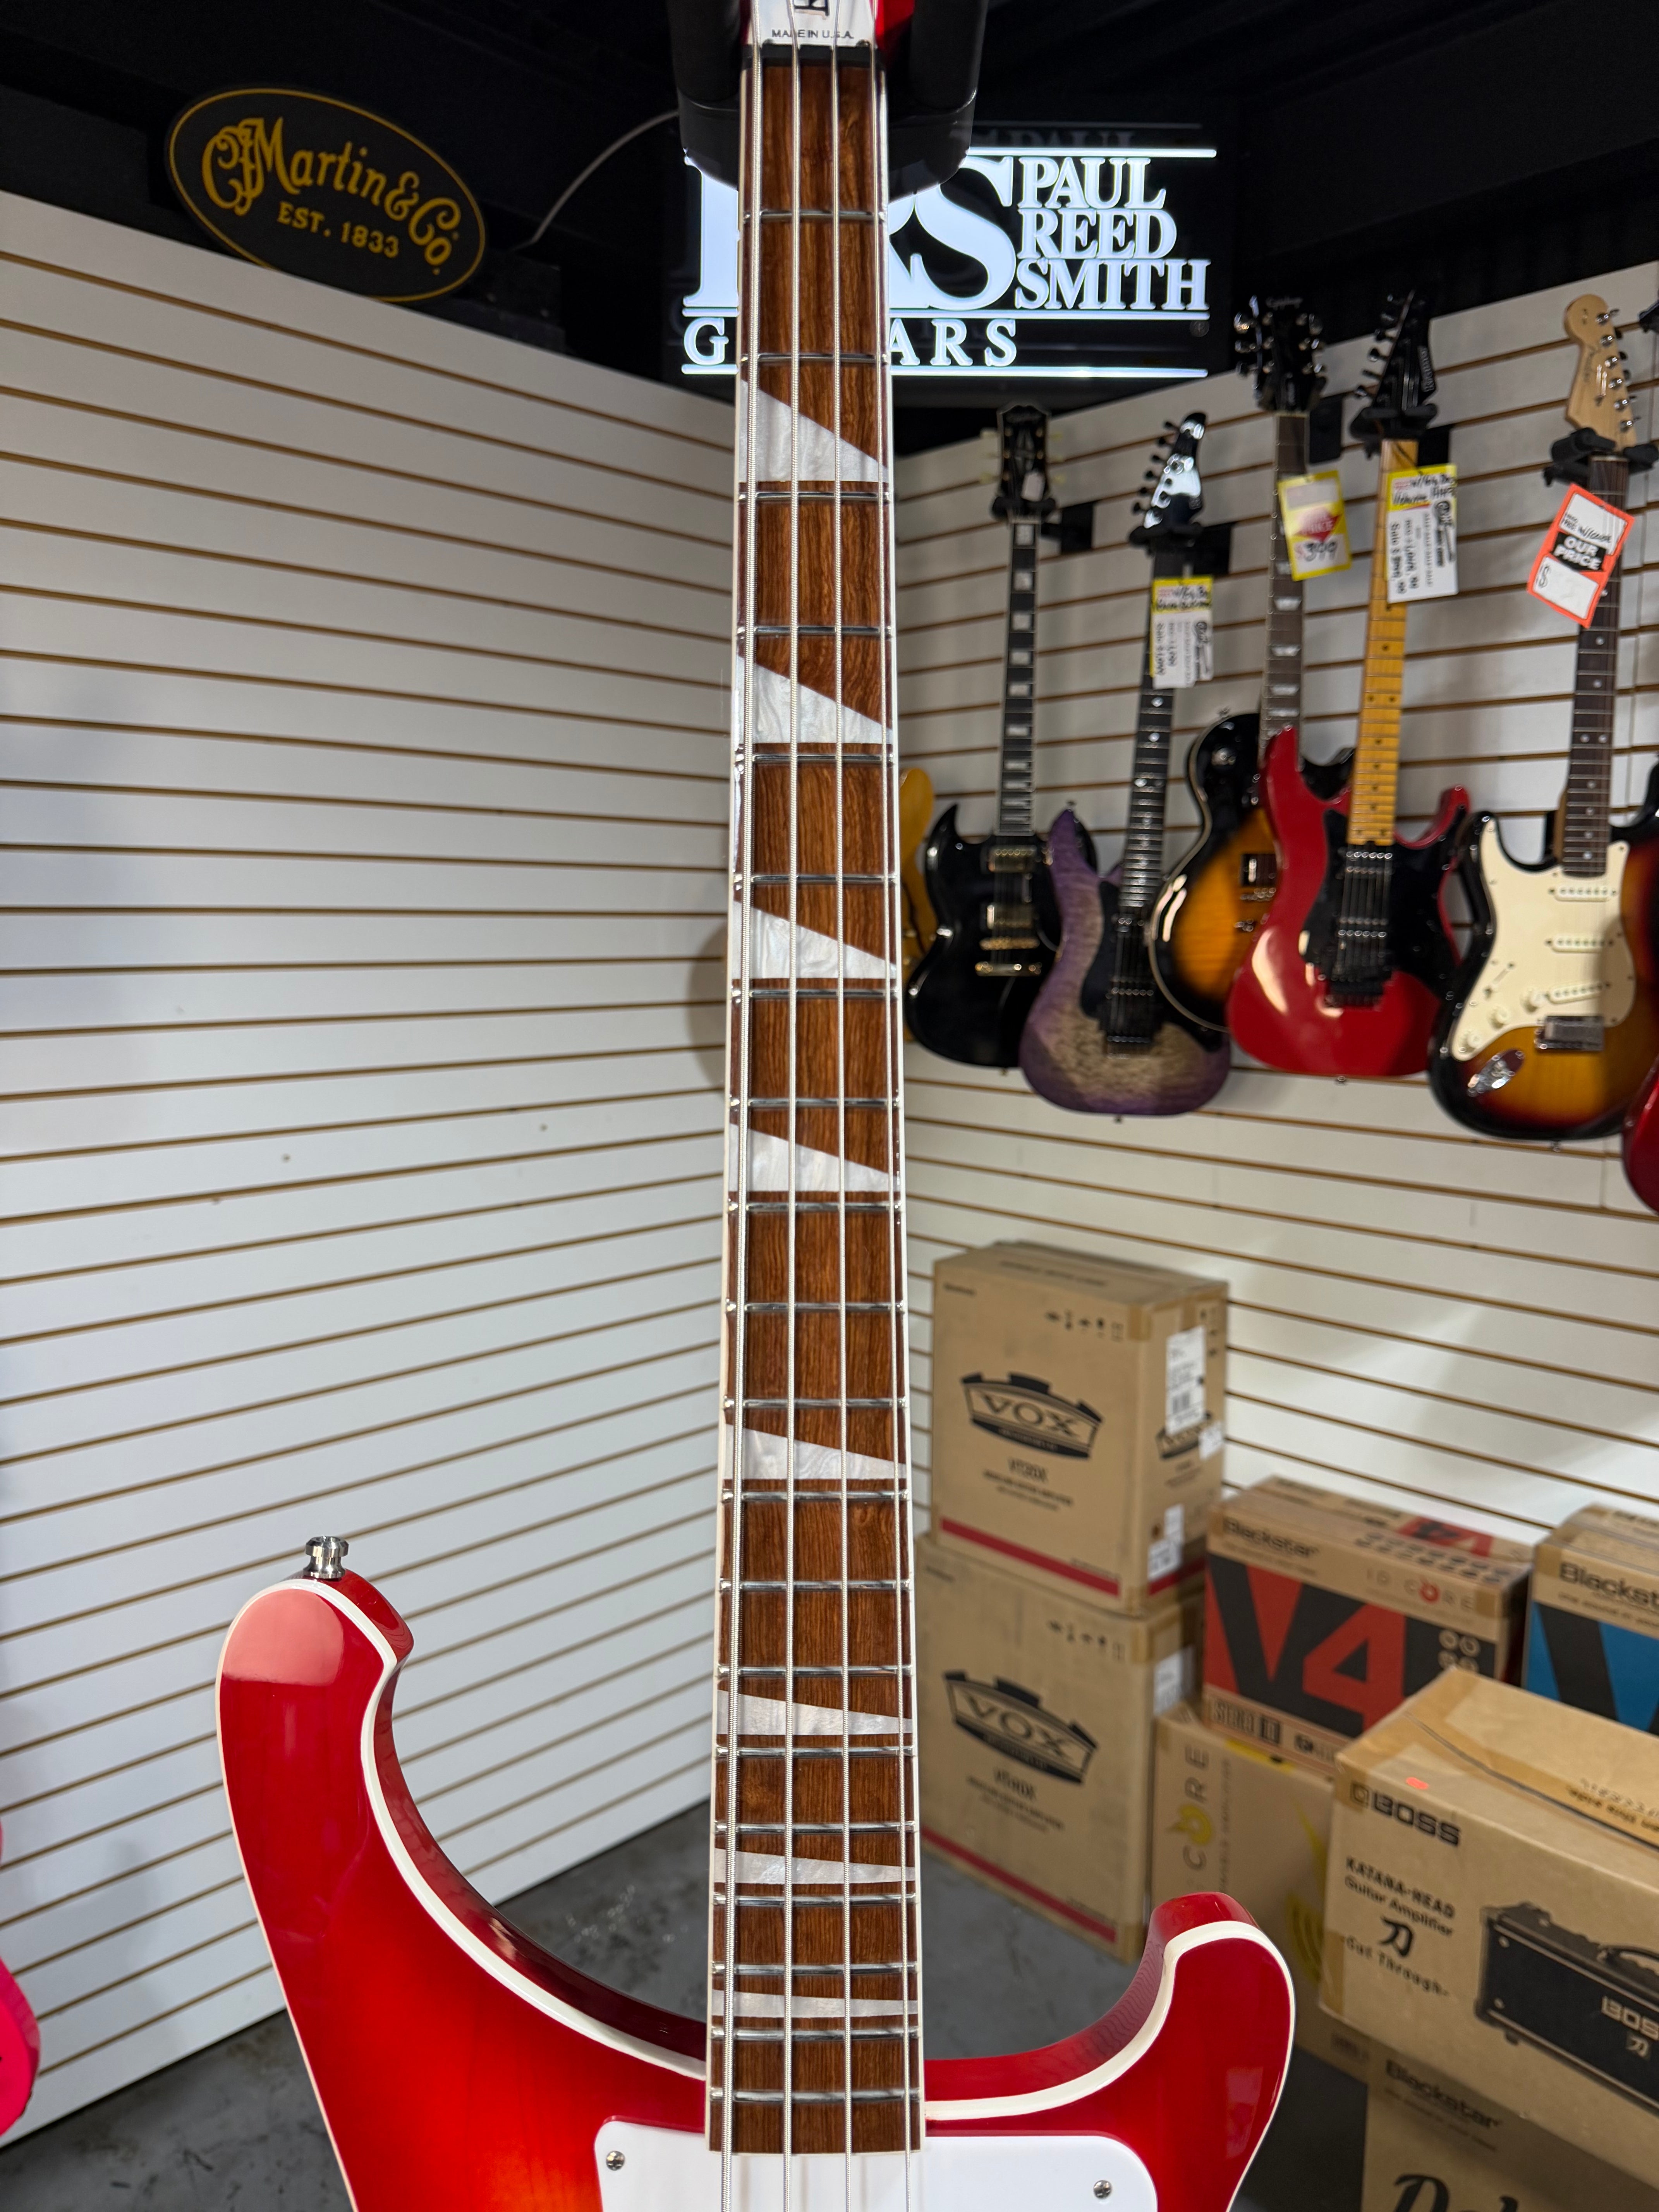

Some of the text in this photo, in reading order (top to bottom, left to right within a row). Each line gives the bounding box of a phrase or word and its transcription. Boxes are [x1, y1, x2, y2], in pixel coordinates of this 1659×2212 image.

[771, 29, 805, 38] MAE
[807, 29, 819, 38] IN
[1018, 157, 1166, 210] PAUL
[277, 201, 399, 258] EST. 1833
[1017, 208, 1177, 260] REED
[1015, 259, 1211, 311] SMITH
[684, 318, 1017, 366] GARS
[1553, 543, 1603, 570] PRICE
[1563, 535, 1599, 556] OUR
[980, 1391, 1080, 1437] VOX
[1223, 1516, 1320, 1558] Blackstar
[963, 1688, 1073, 1761] VOX
[1373, 1790, 1461, 1848] BOSS
[1345, 1875, 1453, 1937] Guitar Amplifier
[1346, 1856, 1455, 1919] KATANA-HEAD
[1385, 2058, 1503, 2130] Blackstar
